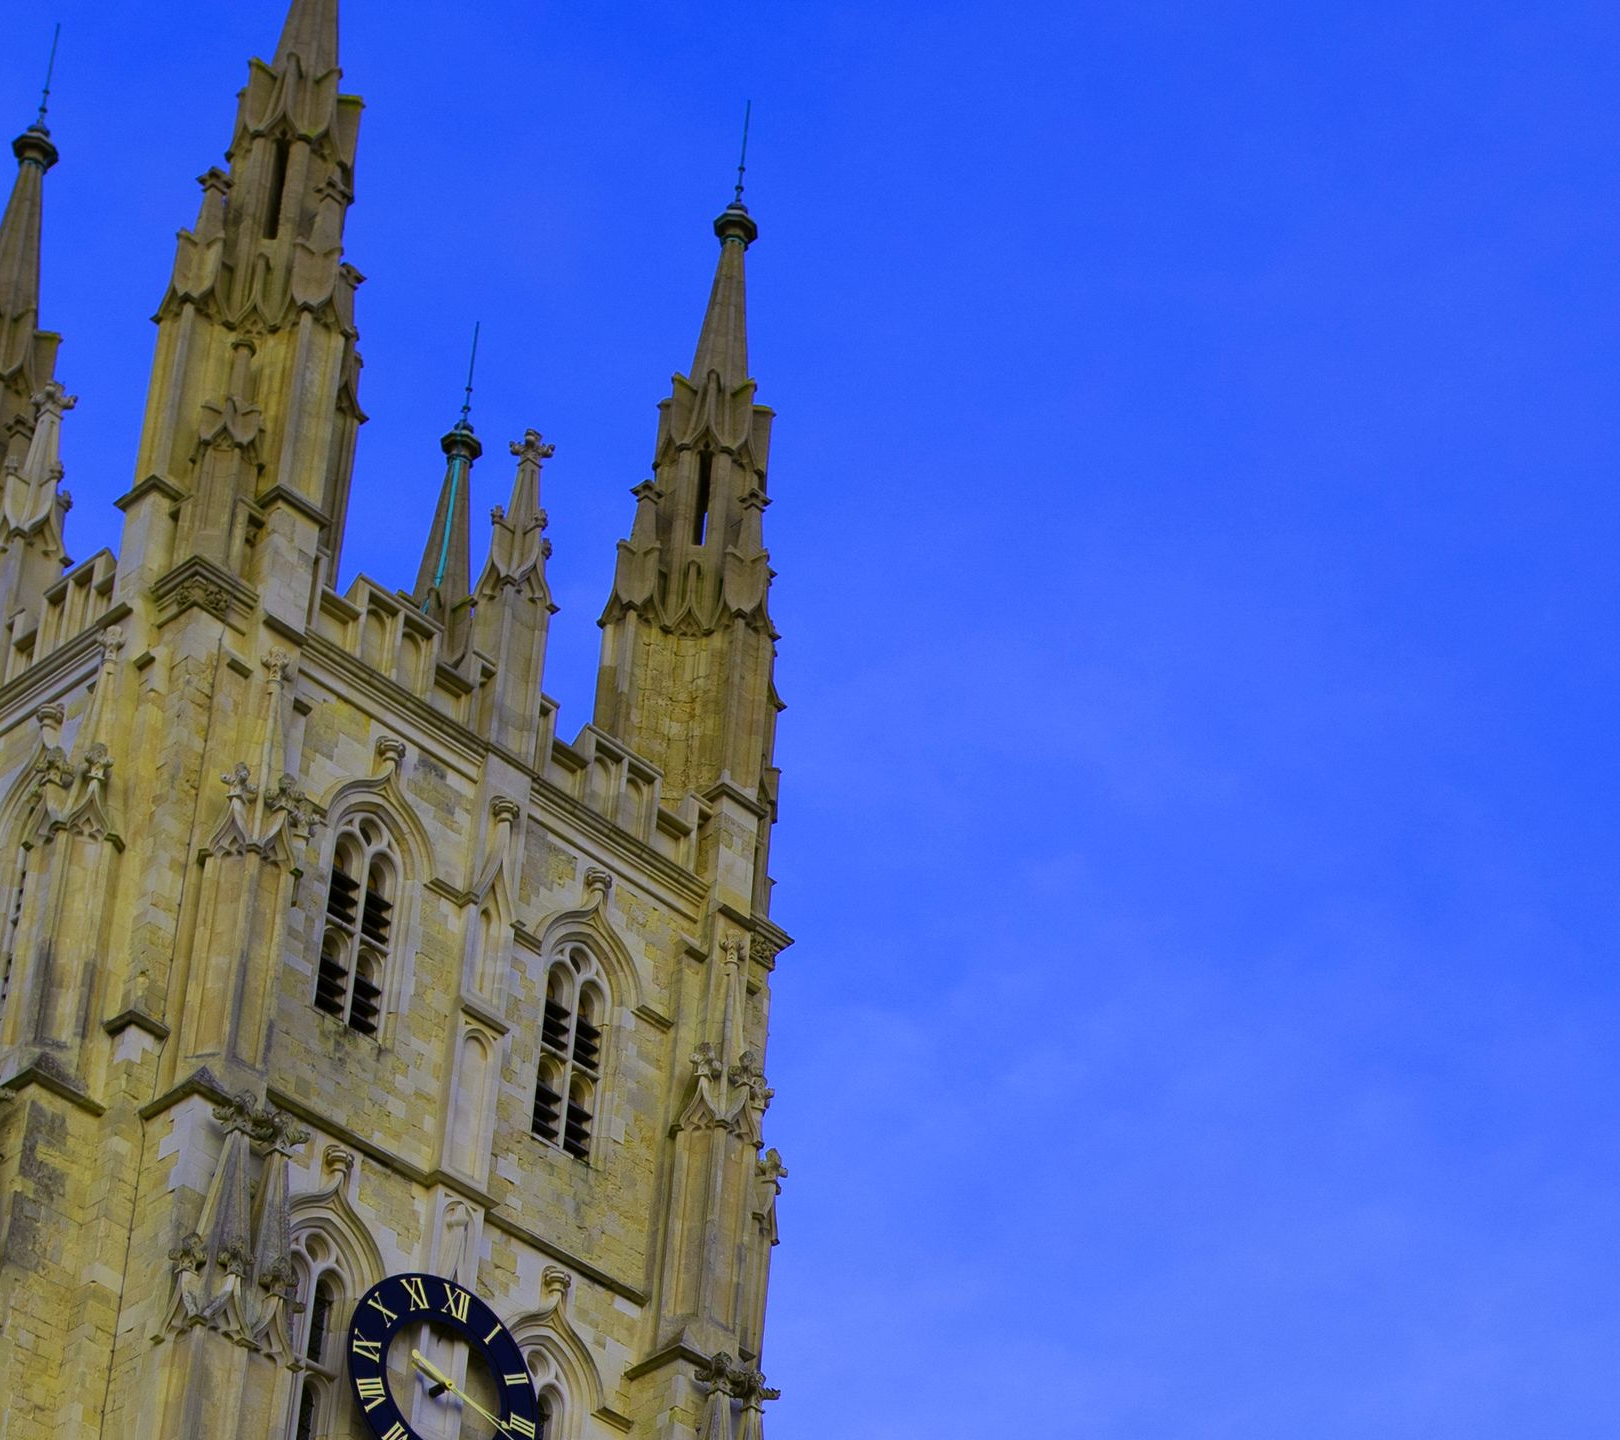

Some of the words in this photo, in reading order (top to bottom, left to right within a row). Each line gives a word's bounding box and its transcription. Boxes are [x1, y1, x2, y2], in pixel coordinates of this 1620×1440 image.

[368, 1292, 398, 1328] X
[401, 1277, 430, 1311] XI
[441, 1284, 471, 1323] XII
[353, 1329, 381, 1363] IX
[484, 1323, 502, 1345] I
[356, 1377, 387, 1413] VIII
[505, 1373, 529, 1386] II
[510, 1412, 536, 1440] III
